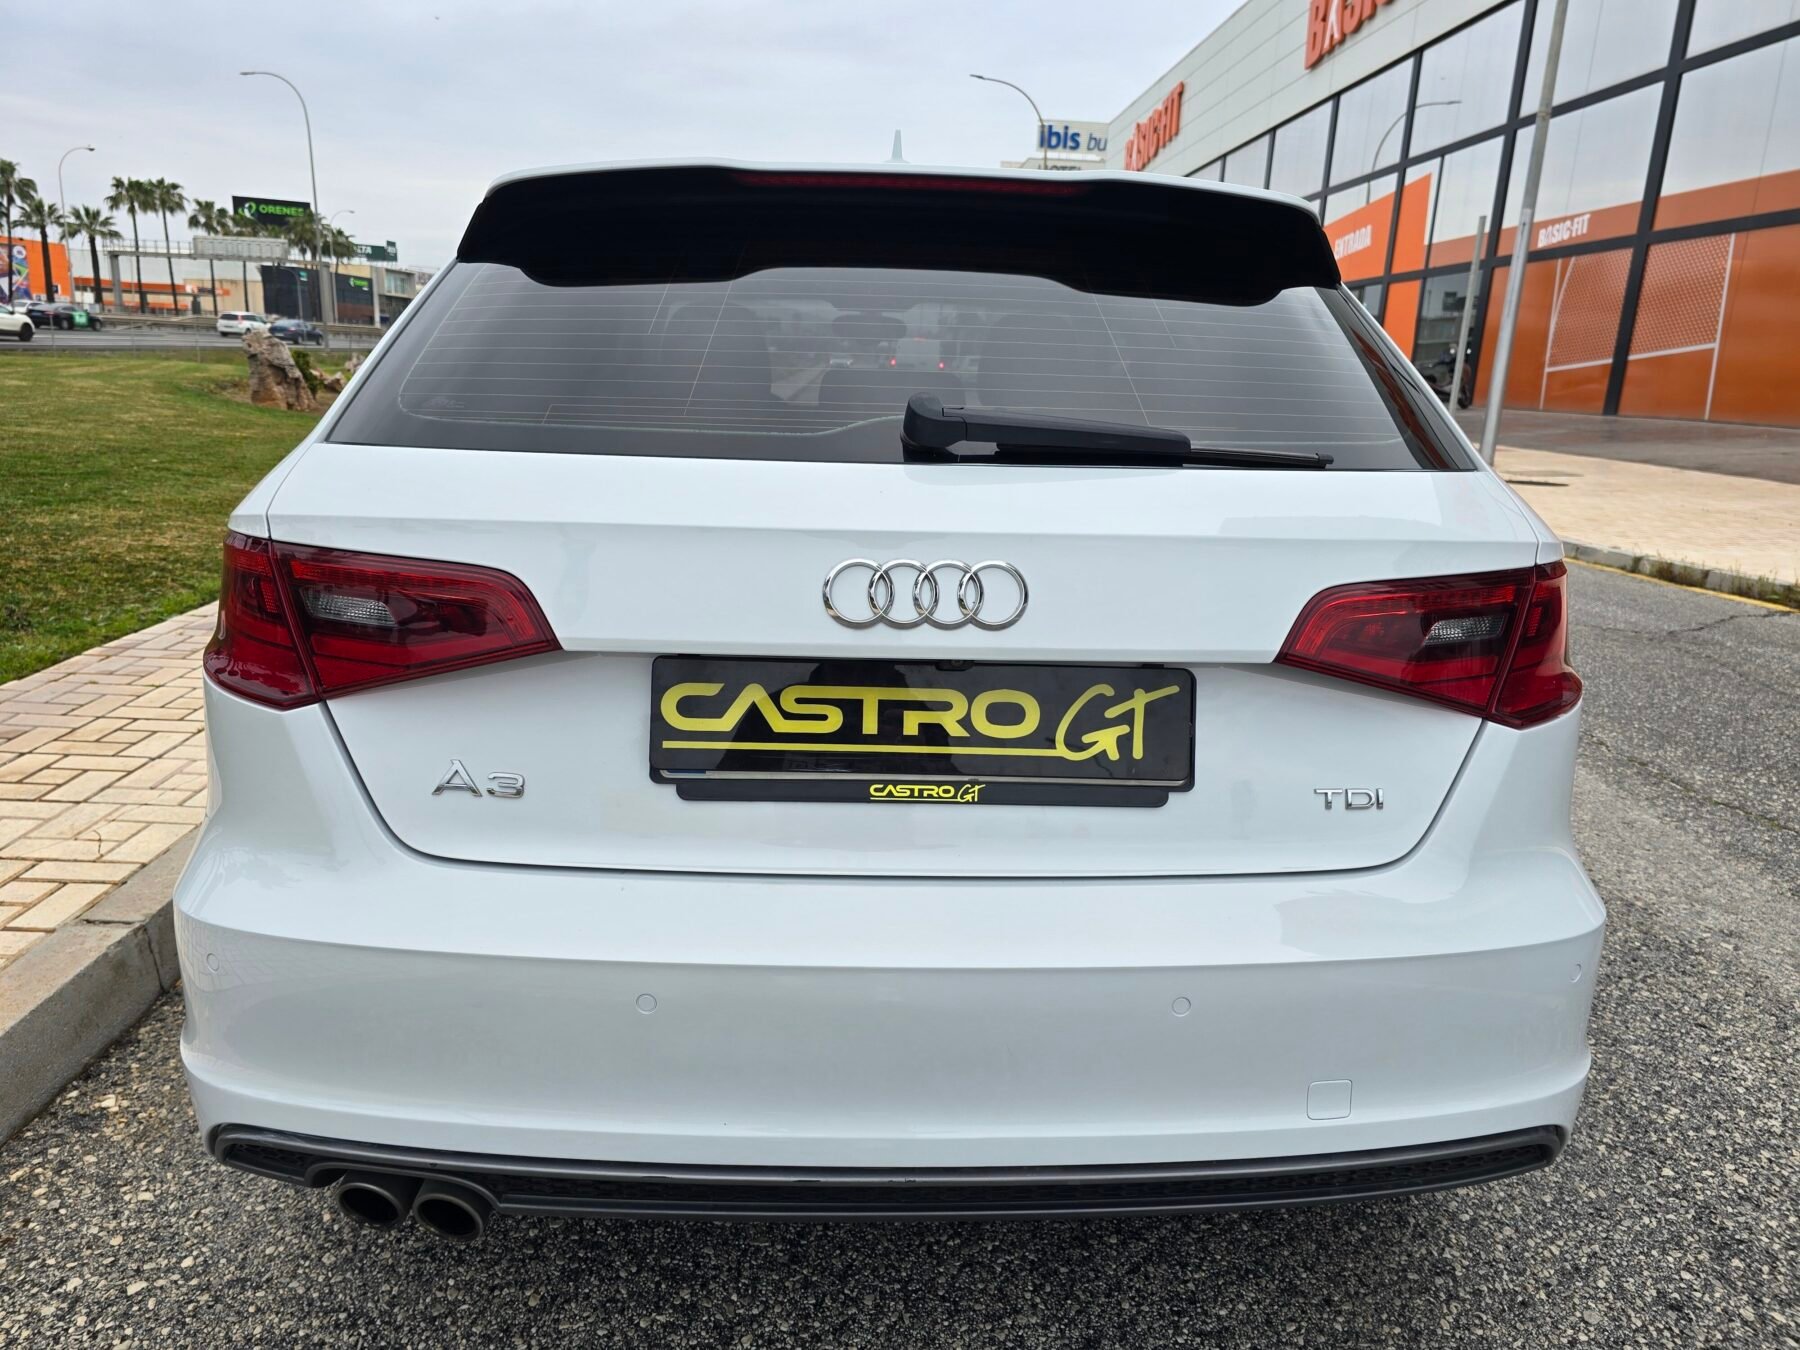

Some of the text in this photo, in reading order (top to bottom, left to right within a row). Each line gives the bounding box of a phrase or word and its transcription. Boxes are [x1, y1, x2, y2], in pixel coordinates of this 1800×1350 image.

[1039, 124, 1081, 150] ibis
[660, 682, 1180, 761] CASTRO GT
[431, 759, 525, 798] A3
[869, 784, 986, 802] CASTRO GT
[1313, 788, 1384, 811] TDI
